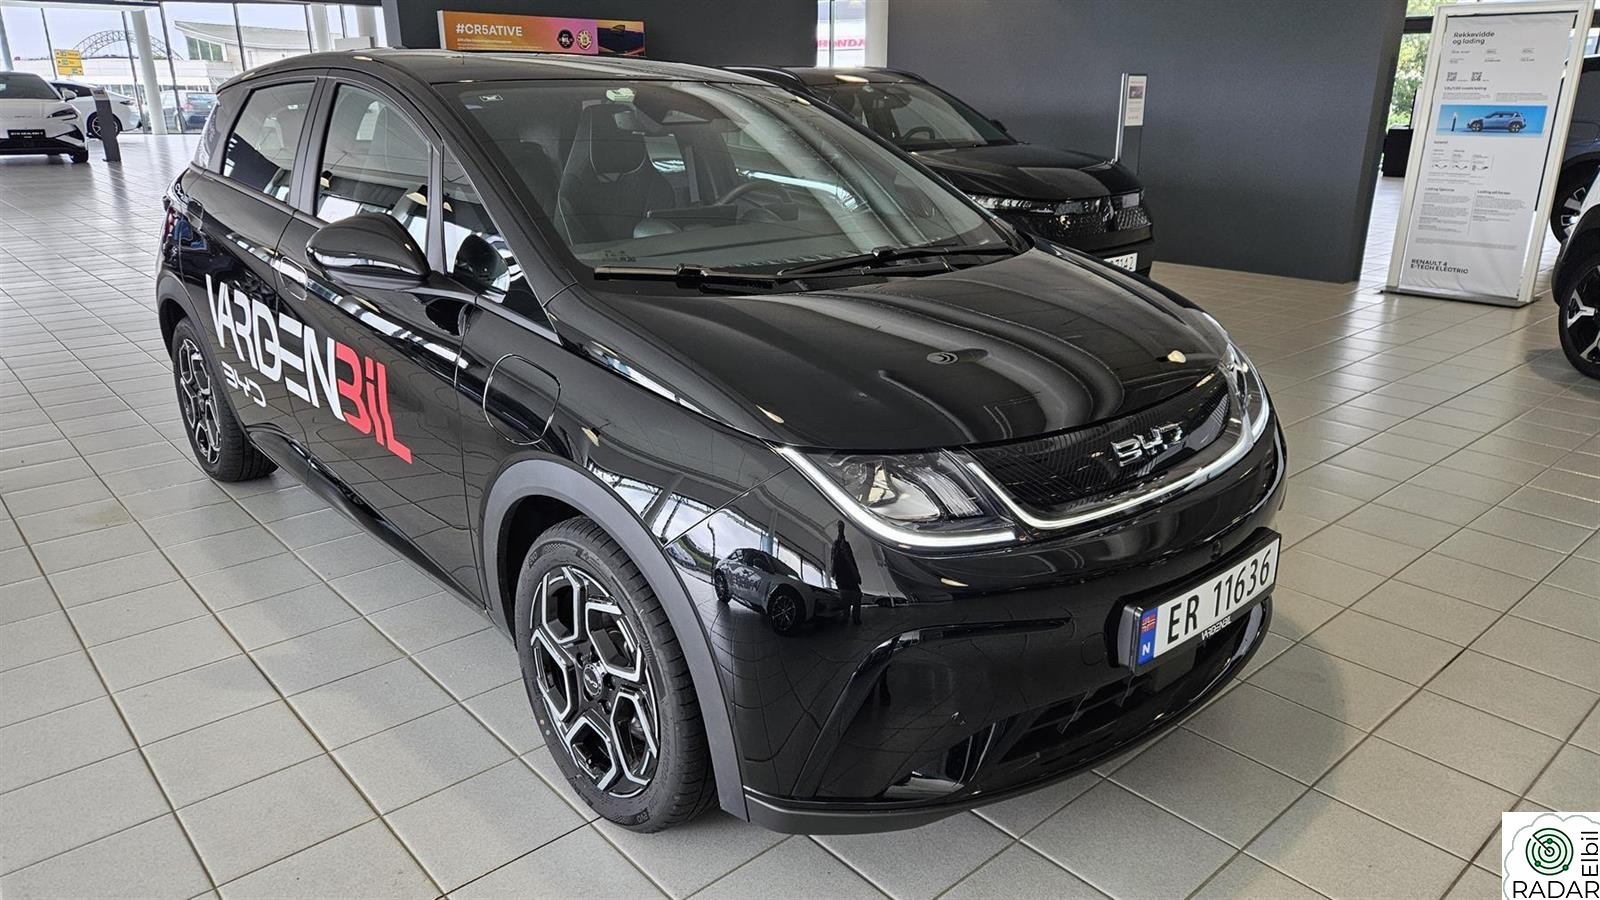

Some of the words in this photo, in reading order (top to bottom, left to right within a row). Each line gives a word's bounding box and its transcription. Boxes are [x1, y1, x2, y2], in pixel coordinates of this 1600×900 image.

[455, 23, 523, 37] #CR5ATIVE
[1435, 266, 1469, 274] ELECTRIC
[221, 361, 267, 408] BYD
[1110, 421, 1183, 467] BYD
[1167, 594, 1200, 645] ER
[1213, 548, 1271, 617] 11636
[1142, 641, 1151, 657] N
